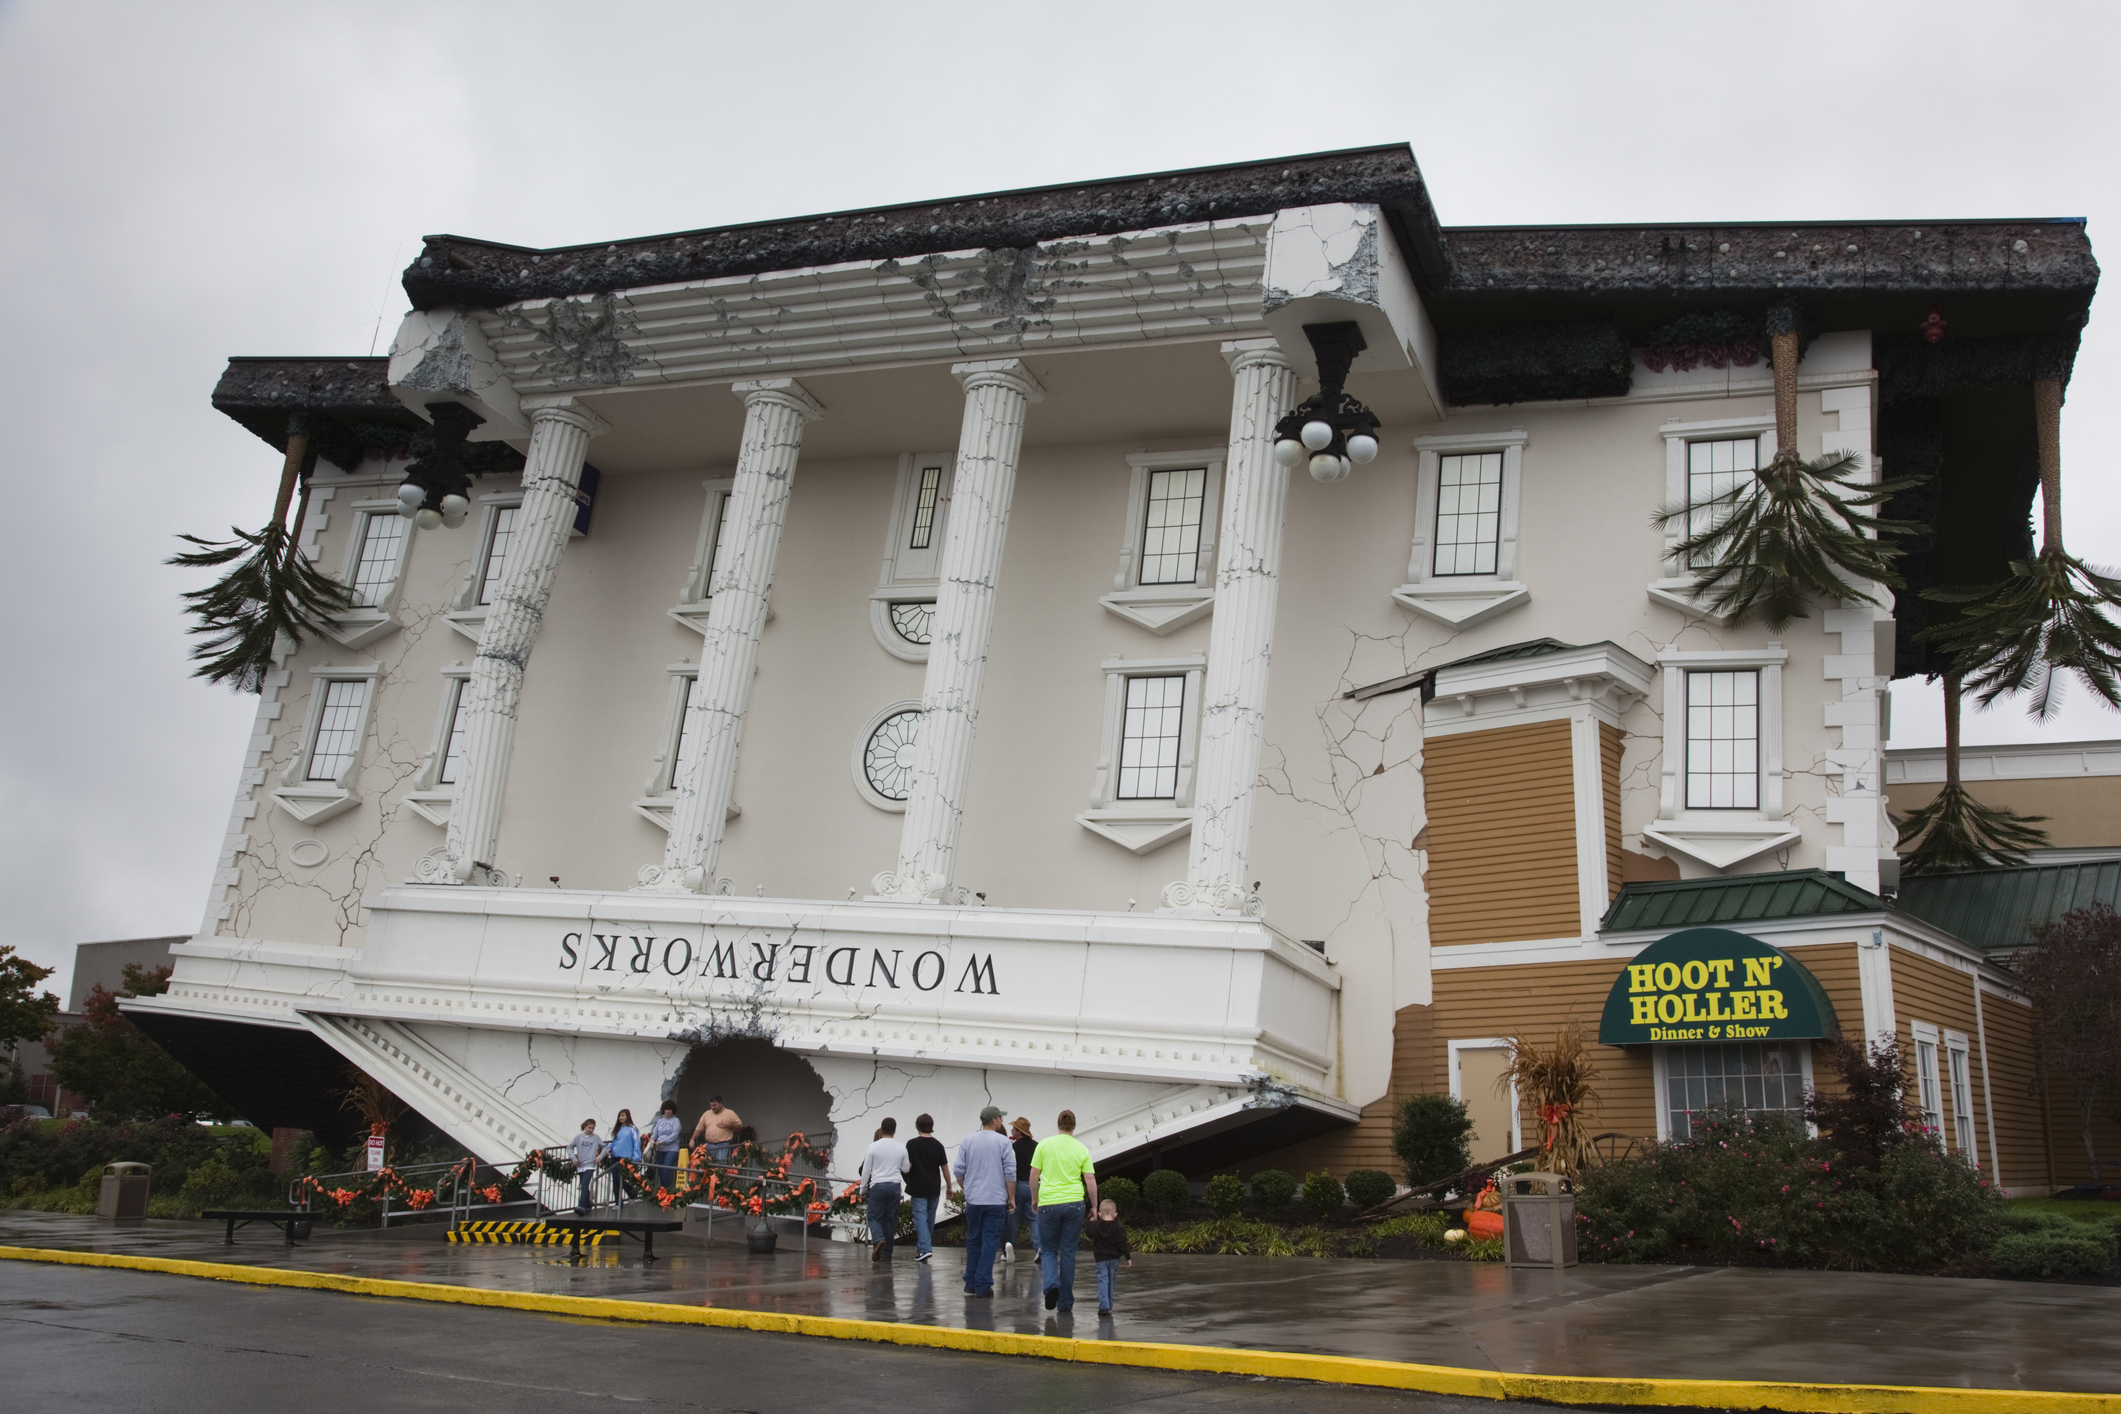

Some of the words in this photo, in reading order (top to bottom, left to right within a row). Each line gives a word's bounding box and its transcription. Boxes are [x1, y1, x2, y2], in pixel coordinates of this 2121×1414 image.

[559, 932, 1001, 995] WONDERWORKS
[1627, 959, 1734, 993] HOOT
[1742, 955, 1783, 987] N'
[1629, 989, 1788, 1024] HOLLER
[1650, 1025, 1704, 1041] Dinner
[1708, 1025, 1721, 1039] &
[1725, 1024, 1770, 1038] Show
